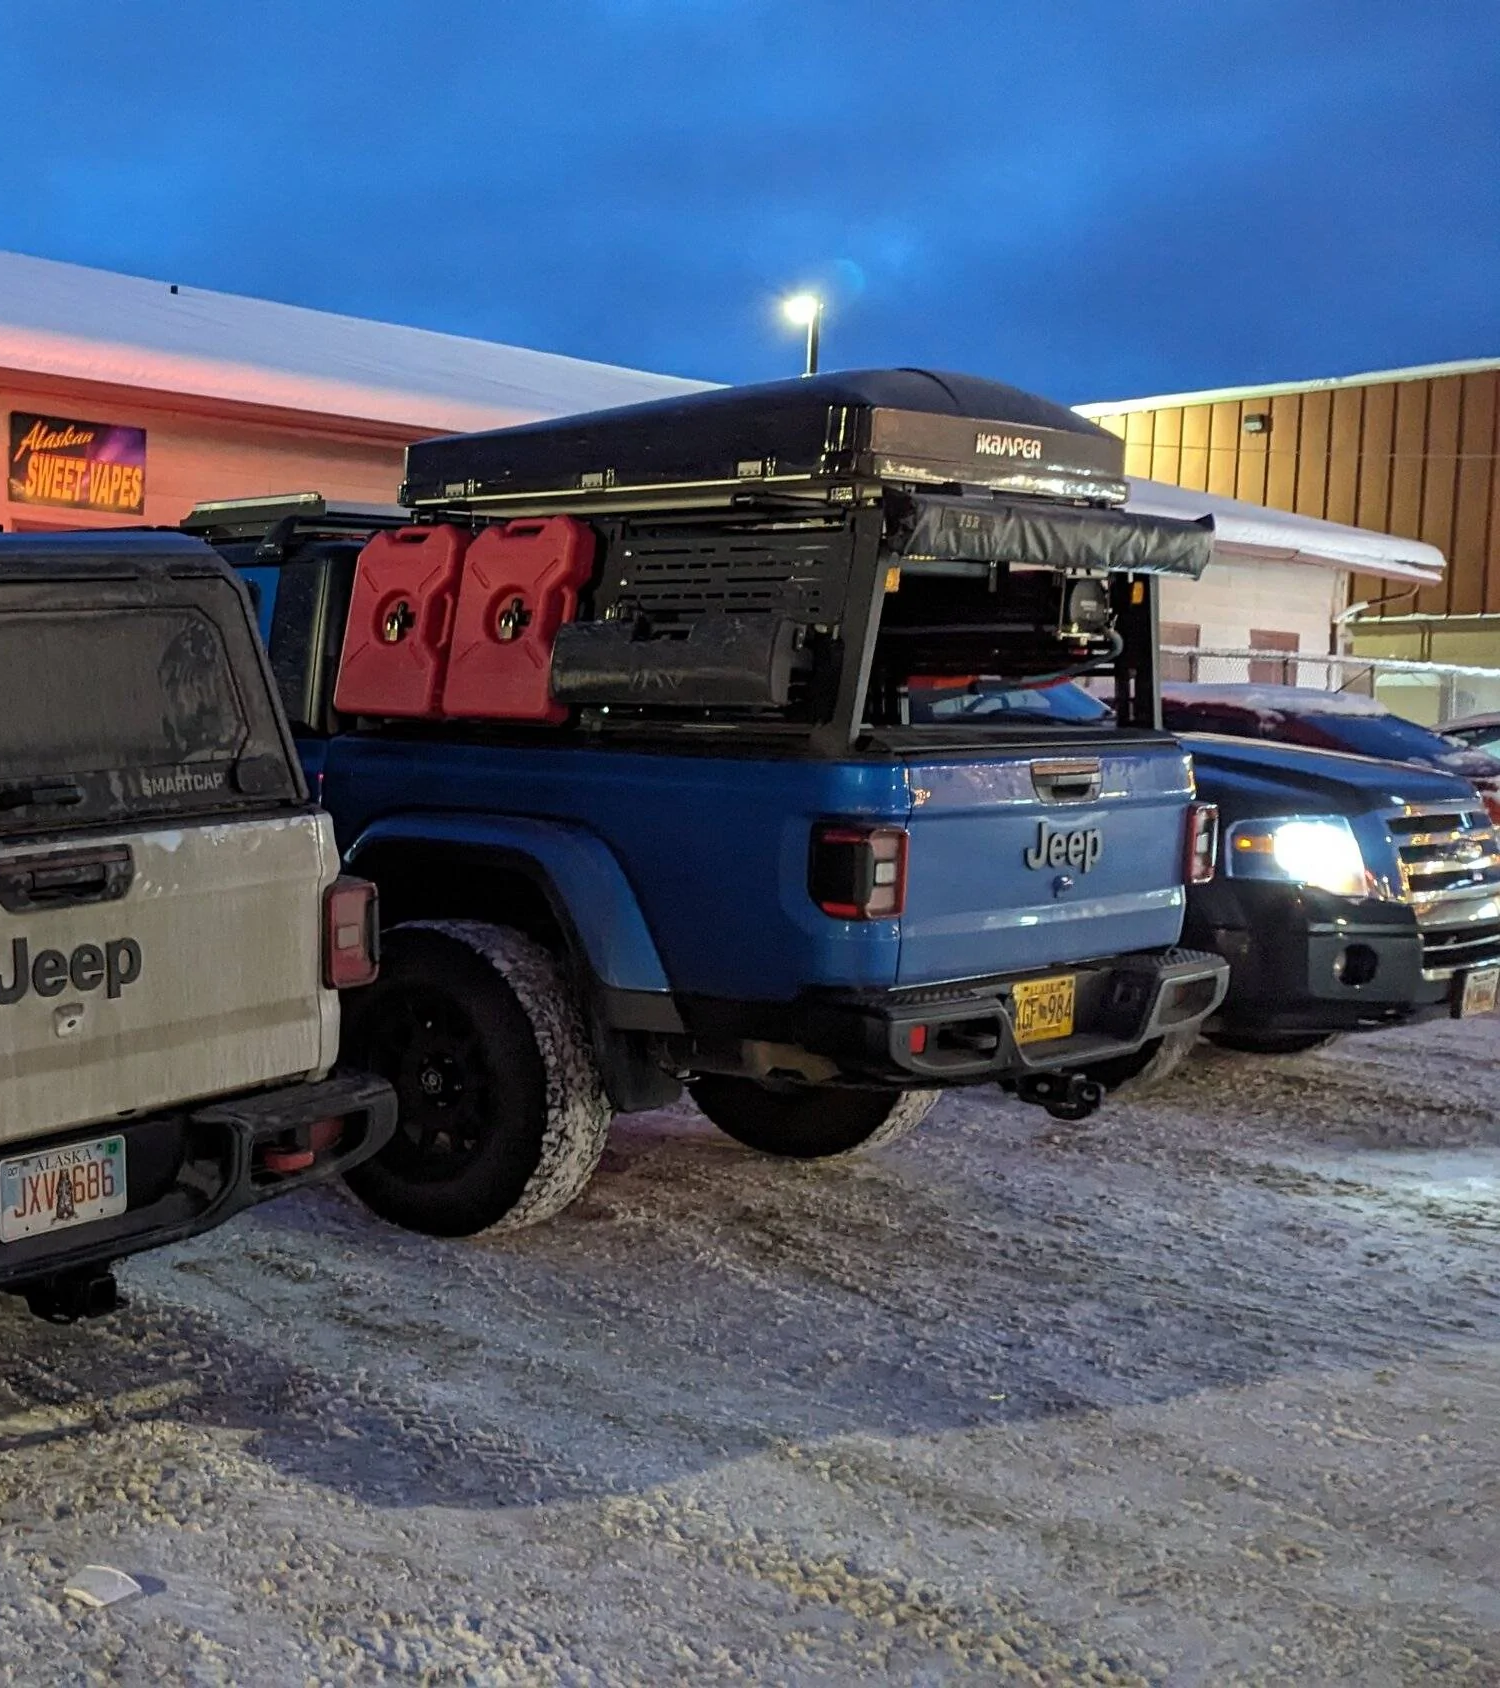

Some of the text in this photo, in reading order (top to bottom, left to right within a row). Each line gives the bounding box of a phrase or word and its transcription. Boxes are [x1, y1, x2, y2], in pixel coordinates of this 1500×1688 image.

[14, 420, 95, 462] Alaskan
[25, 453, 143, 508] SWEET VAPES
[141, 772, 224, 797] SMARTCAP
[1024, 821, 1104, 874] Jeep
[34, 1148, 92, 1173] ALASKA
[14, 1158, 116, 1219] JXV 686
